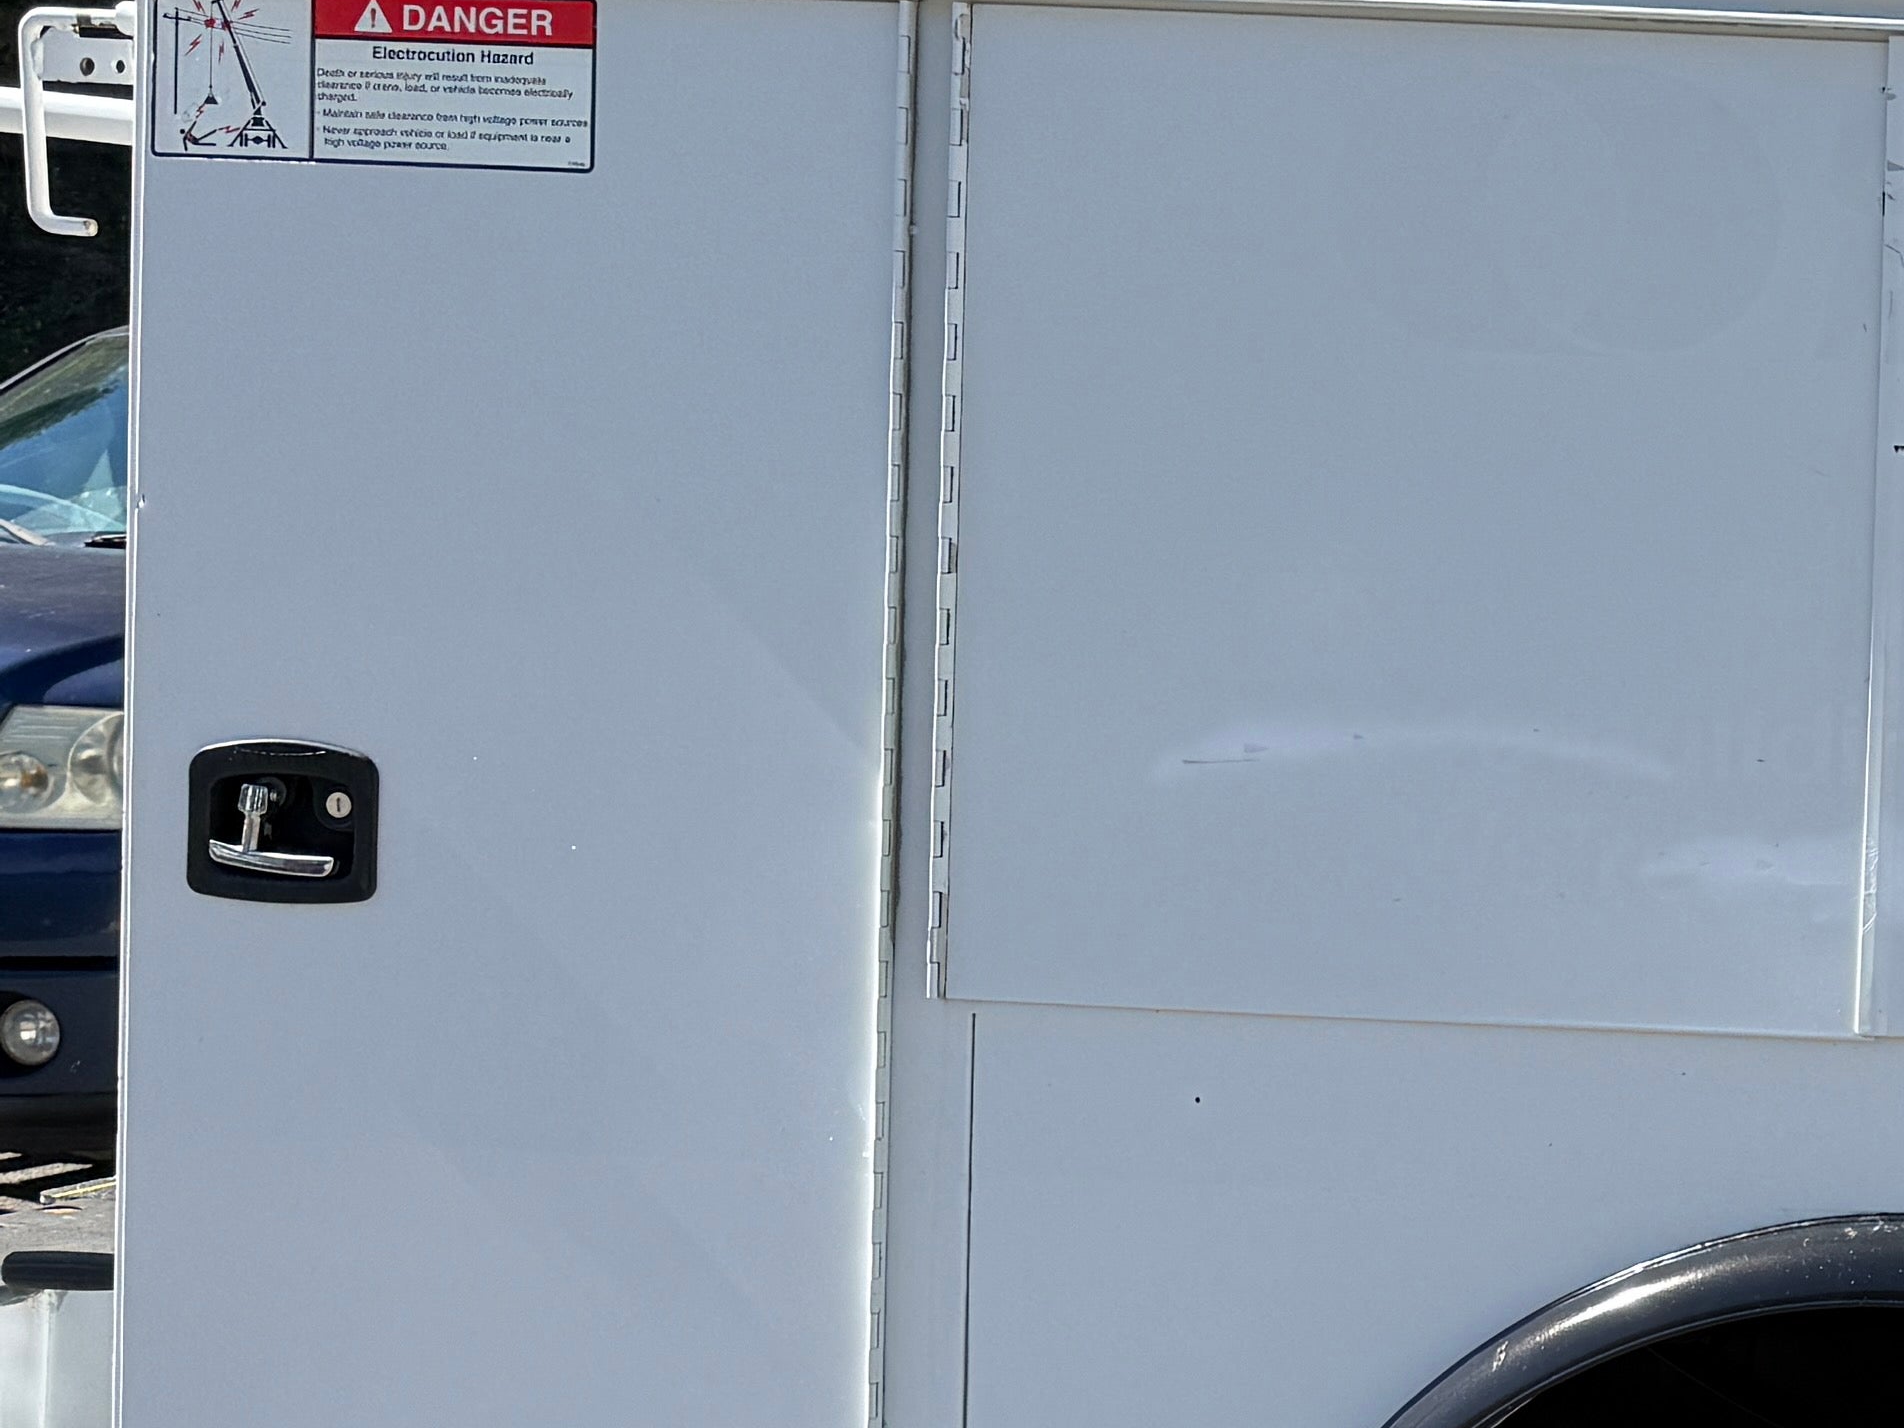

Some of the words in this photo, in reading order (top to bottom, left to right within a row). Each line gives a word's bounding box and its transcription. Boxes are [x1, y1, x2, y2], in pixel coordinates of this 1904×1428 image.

[402, 4, 553, 36] DANGER
[372, 46, 475, 63] Electrocution
[480, 50, 535, 65] Hazard
